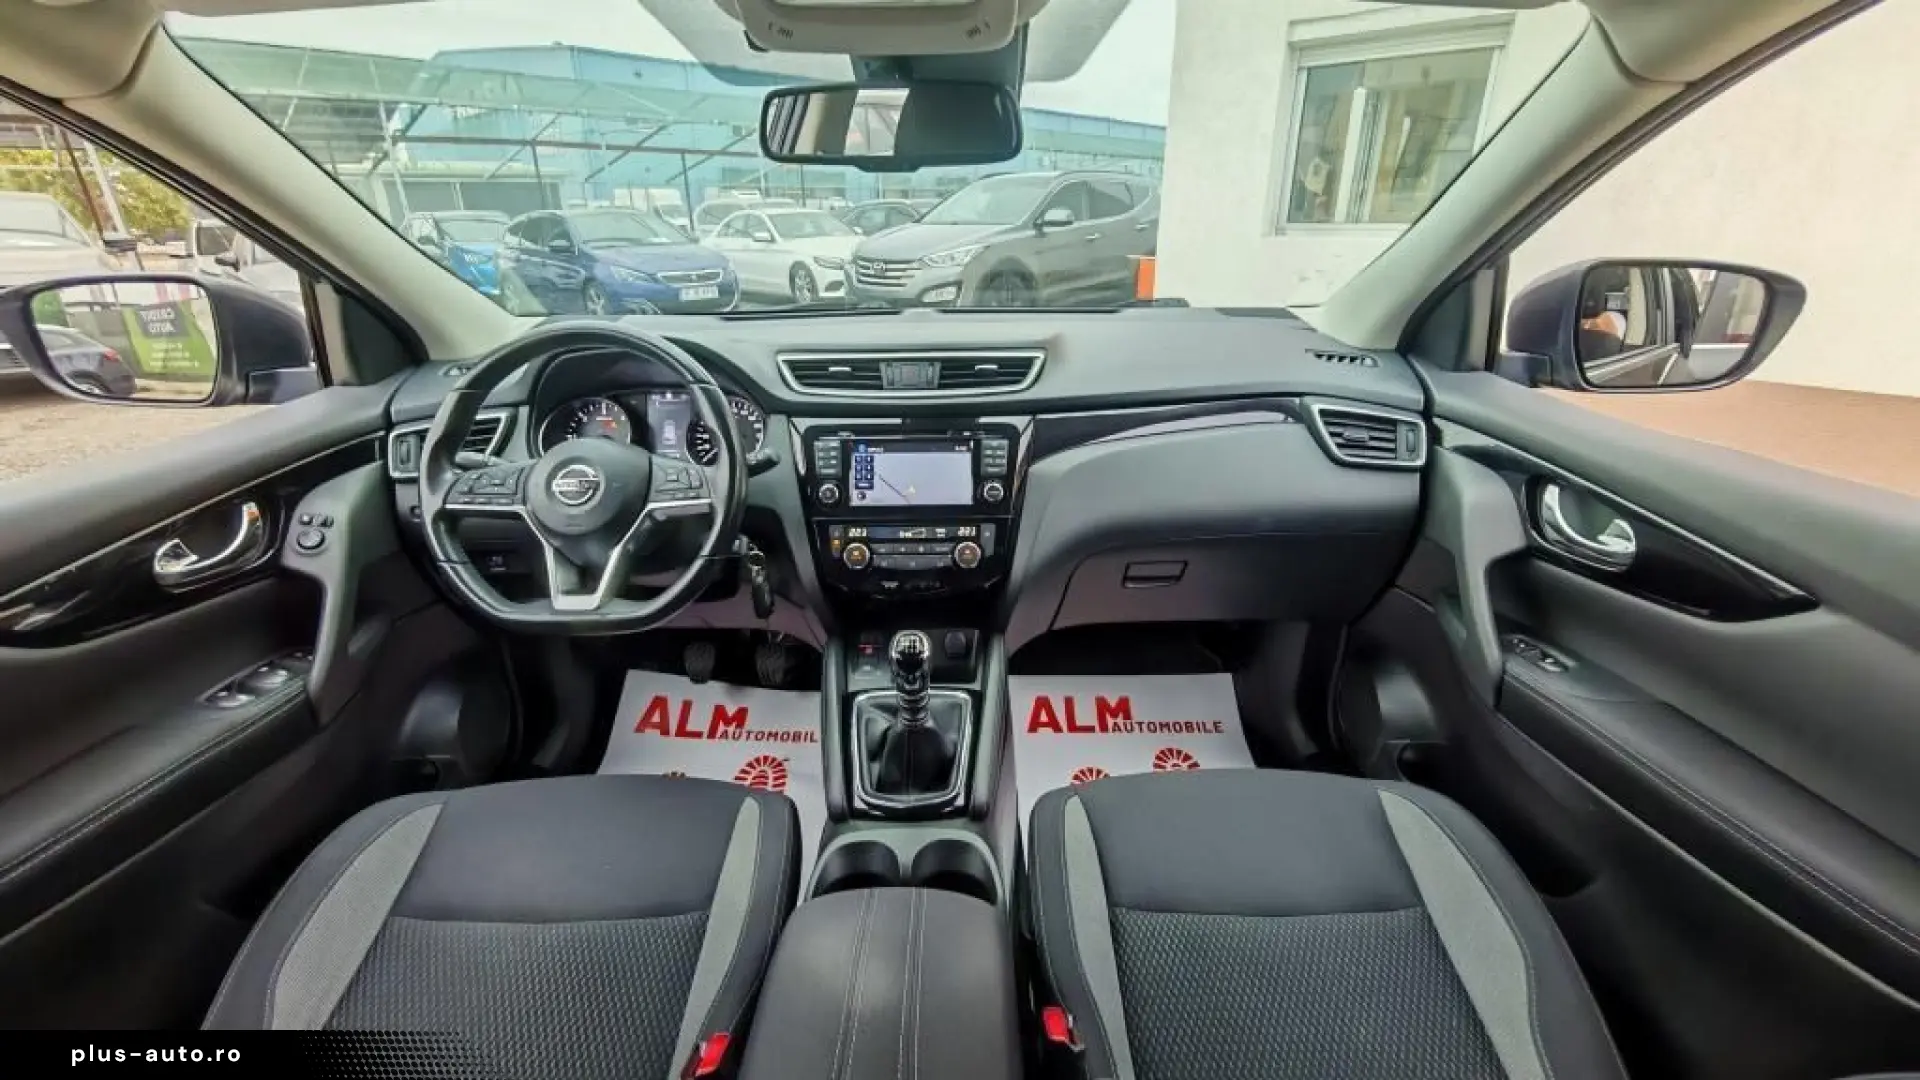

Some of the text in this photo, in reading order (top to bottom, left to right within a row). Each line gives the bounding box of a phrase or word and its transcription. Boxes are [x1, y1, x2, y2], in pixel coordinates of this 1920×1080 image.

[634, 695, 819, 744] ALM AUTOMOBIL
[1026, 695, 1225, 734] ALM AUTOMOBILE
